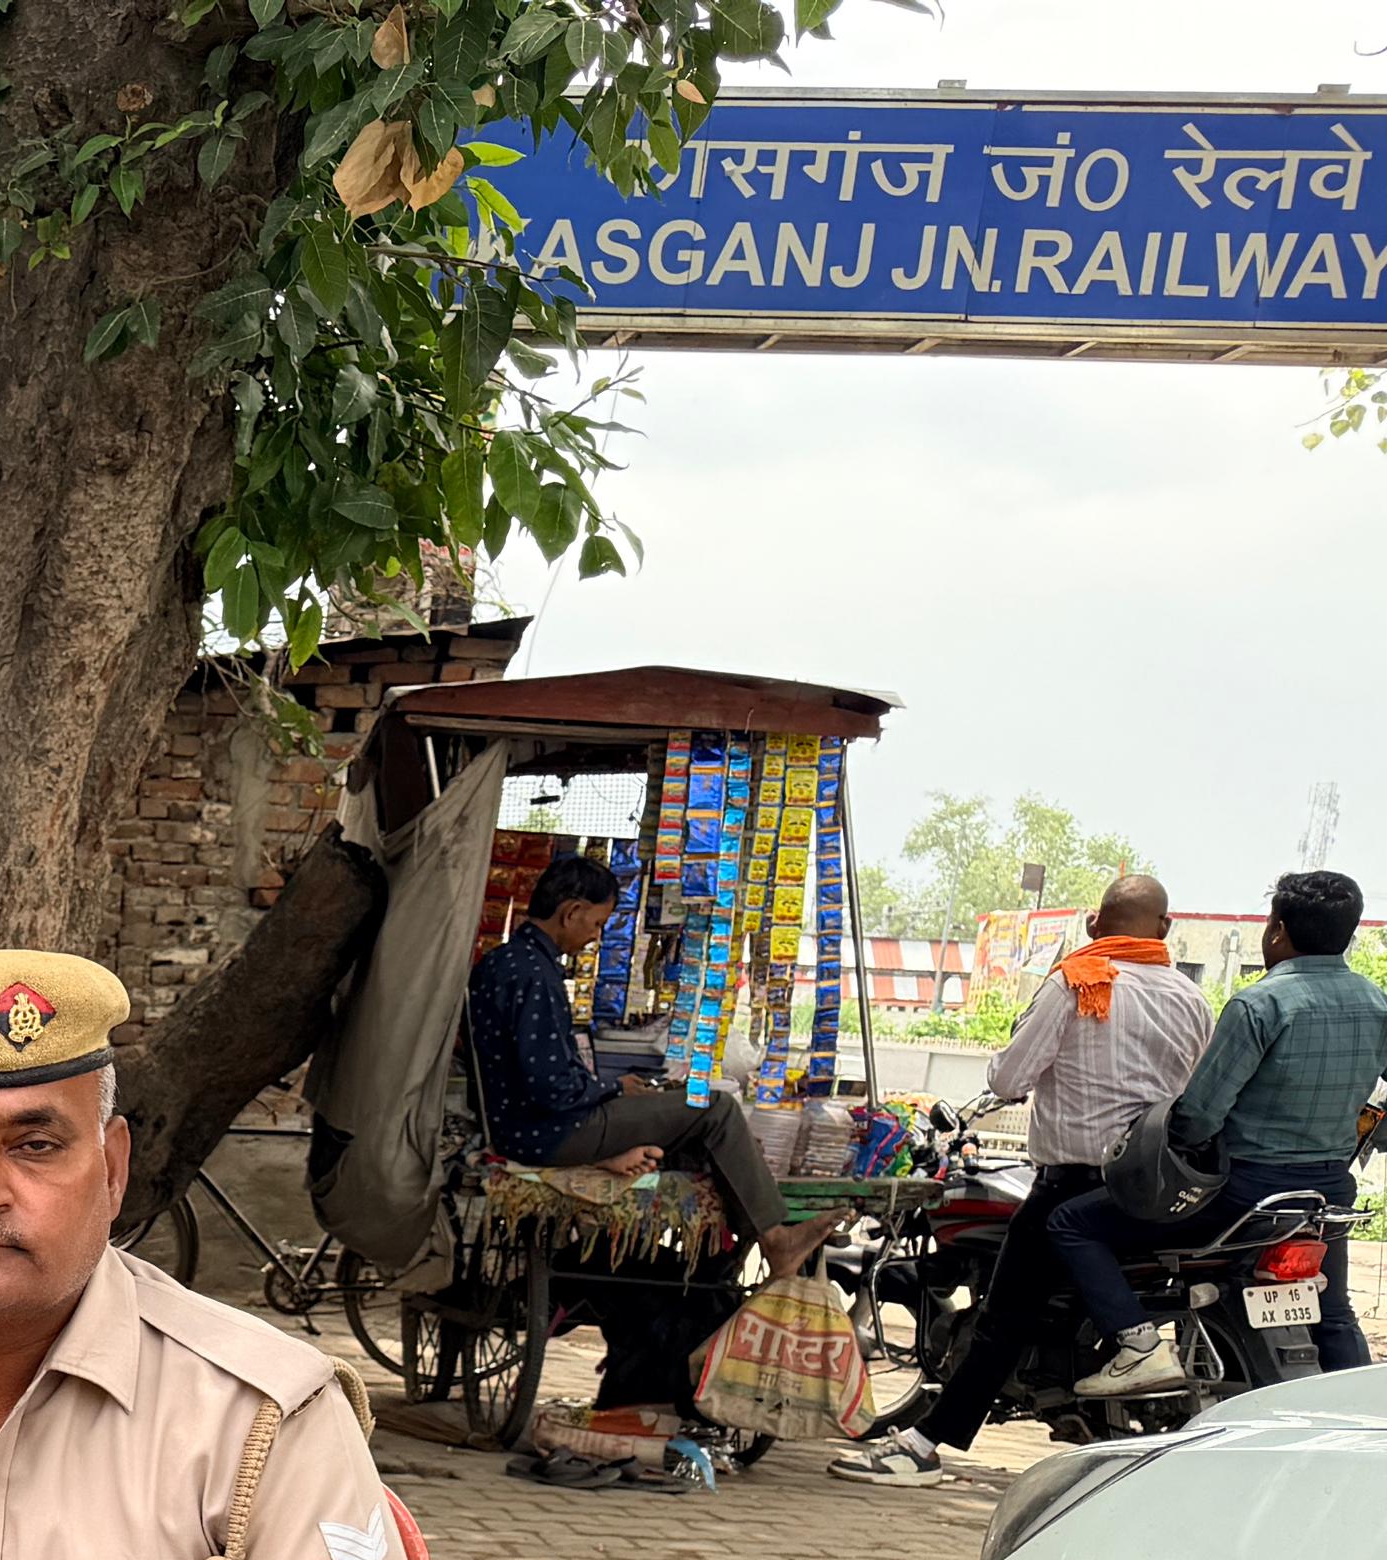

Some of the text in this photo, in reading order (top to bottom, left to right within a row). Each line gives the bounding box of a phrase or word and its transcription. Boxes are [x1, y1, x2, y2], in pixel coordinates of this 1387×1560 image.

[1164, 122, 1373, 211] रेलवे
[1264, 1289, 1300, 1303] UP 16
[1262, 1307, 1312, 1323] AX 8335
